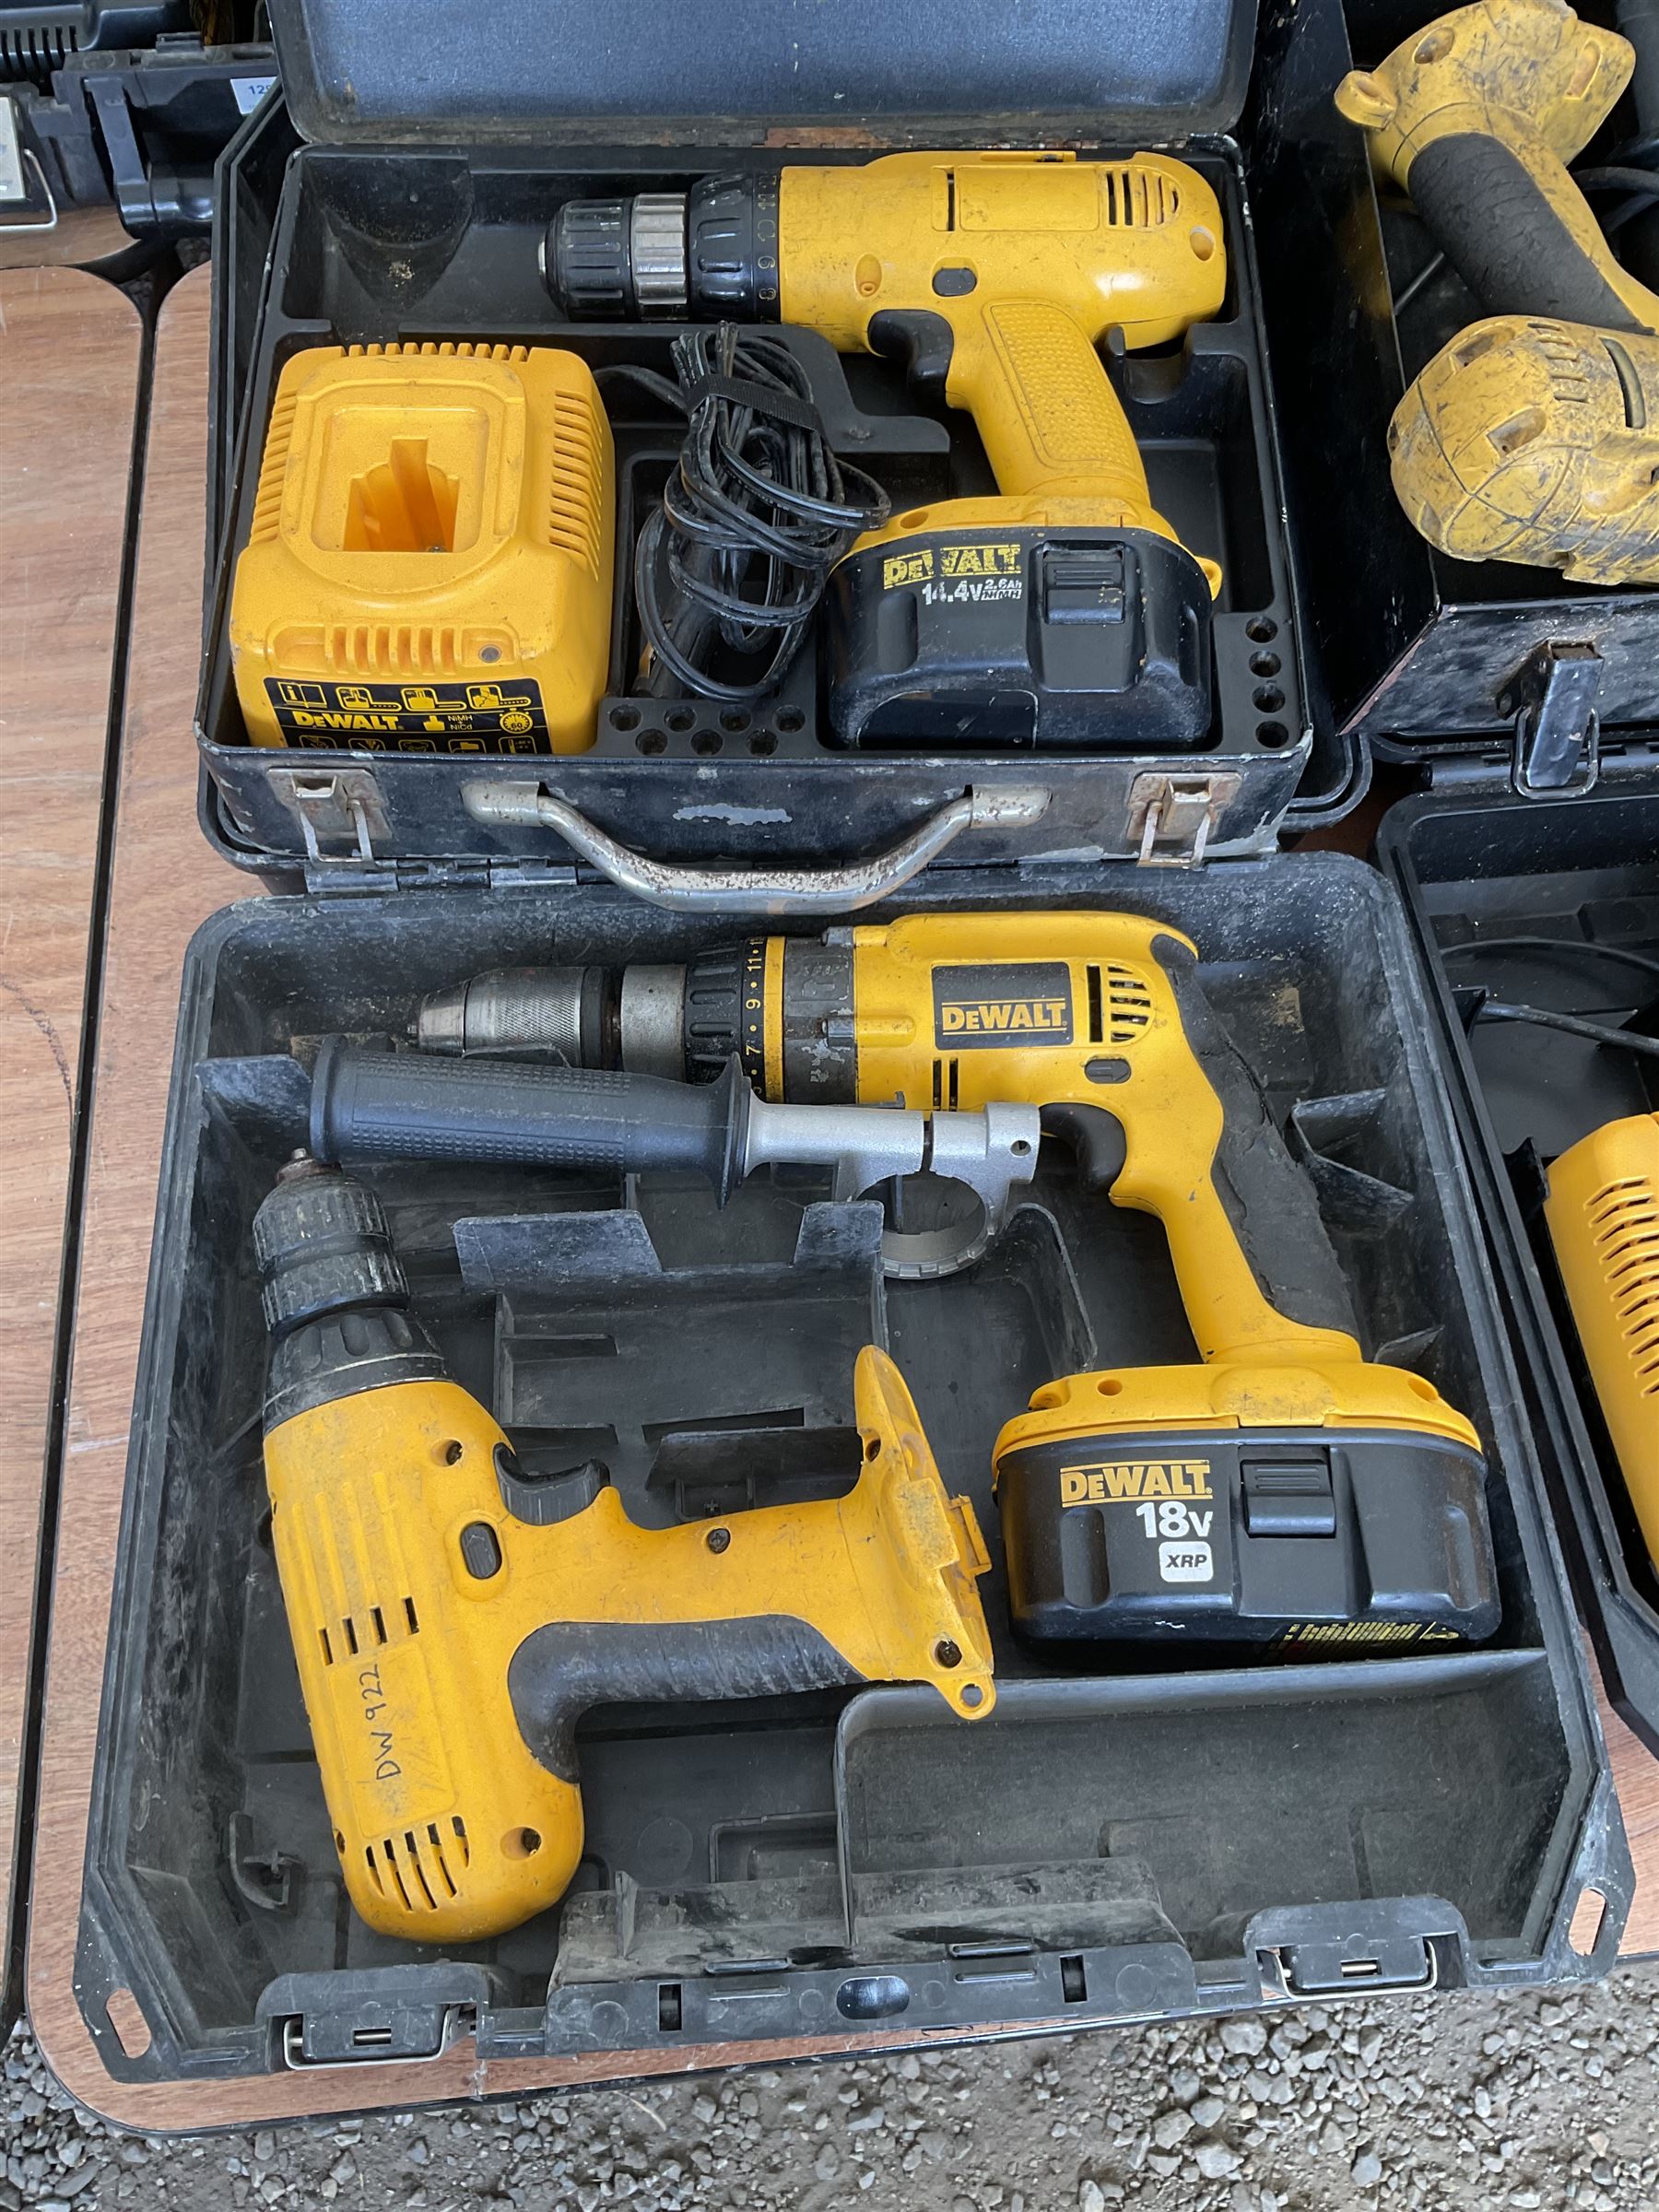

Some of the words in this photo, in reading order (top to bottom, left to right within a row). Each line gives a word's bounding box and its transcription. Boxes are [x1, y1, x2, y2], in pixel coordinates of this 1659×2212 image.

[745, 998, 761, 1010] 9
[745, 1039, 761, 1056] 7
[1165, 1554, 1207, 1570] XRP
